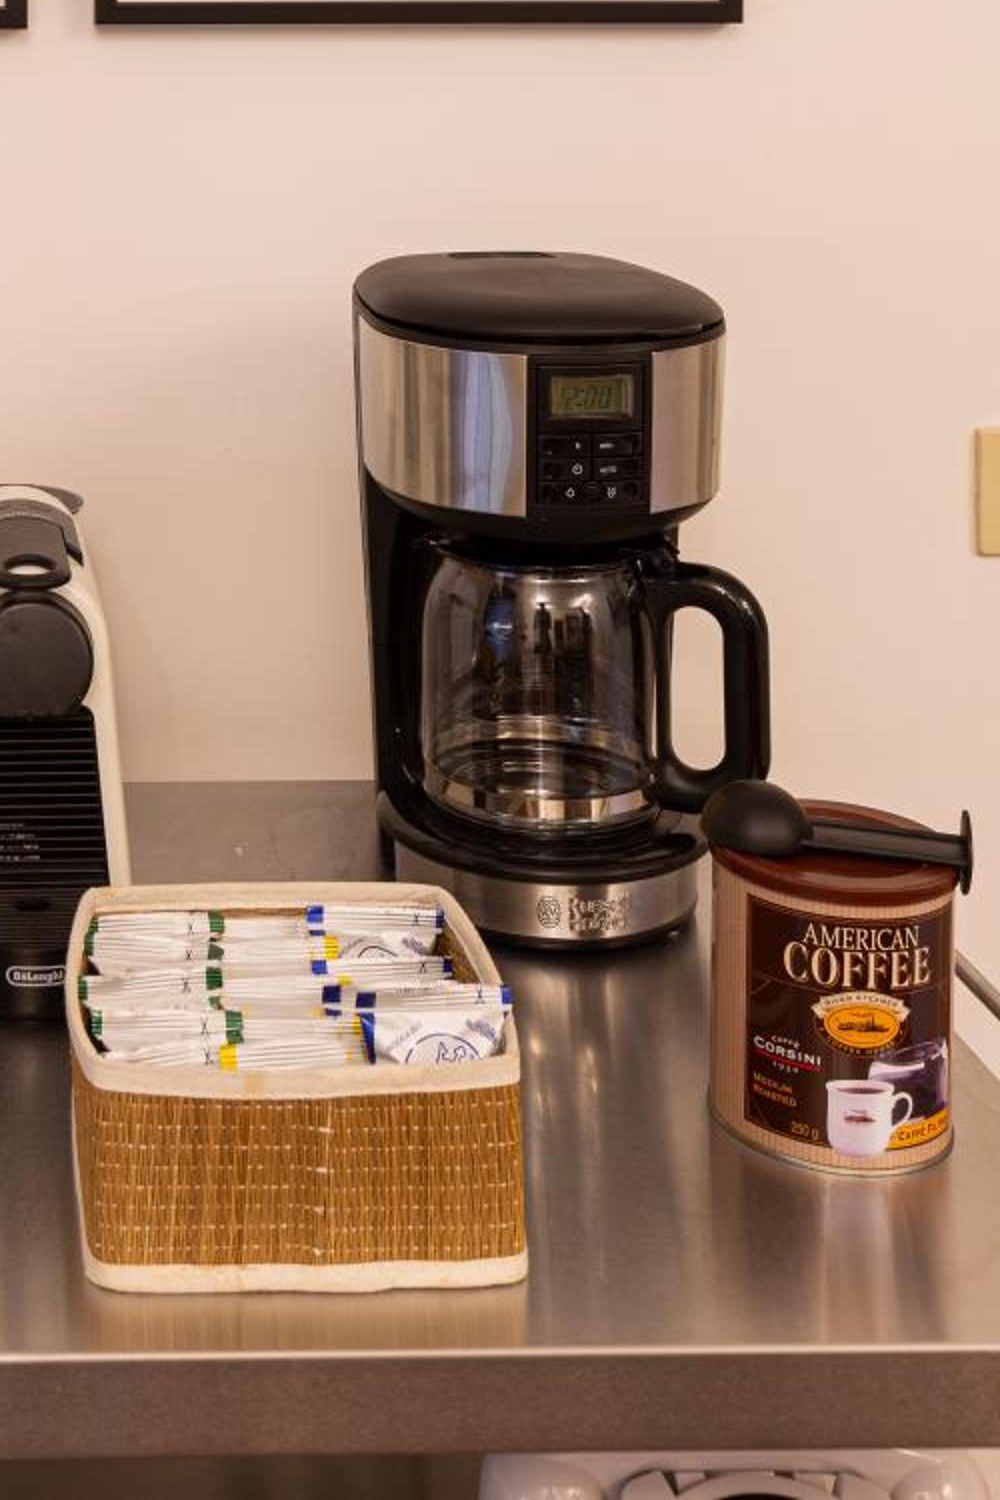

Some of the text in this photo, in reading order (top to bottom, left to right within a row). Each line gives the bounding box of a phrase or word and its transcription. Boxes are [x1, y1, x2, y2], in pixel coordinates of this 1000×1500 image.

[802, 921, 920, 951] AMERICAN
[783, 940, 931, 990] COFFEE
[753, 1035, 822, 1066] CORSINI
